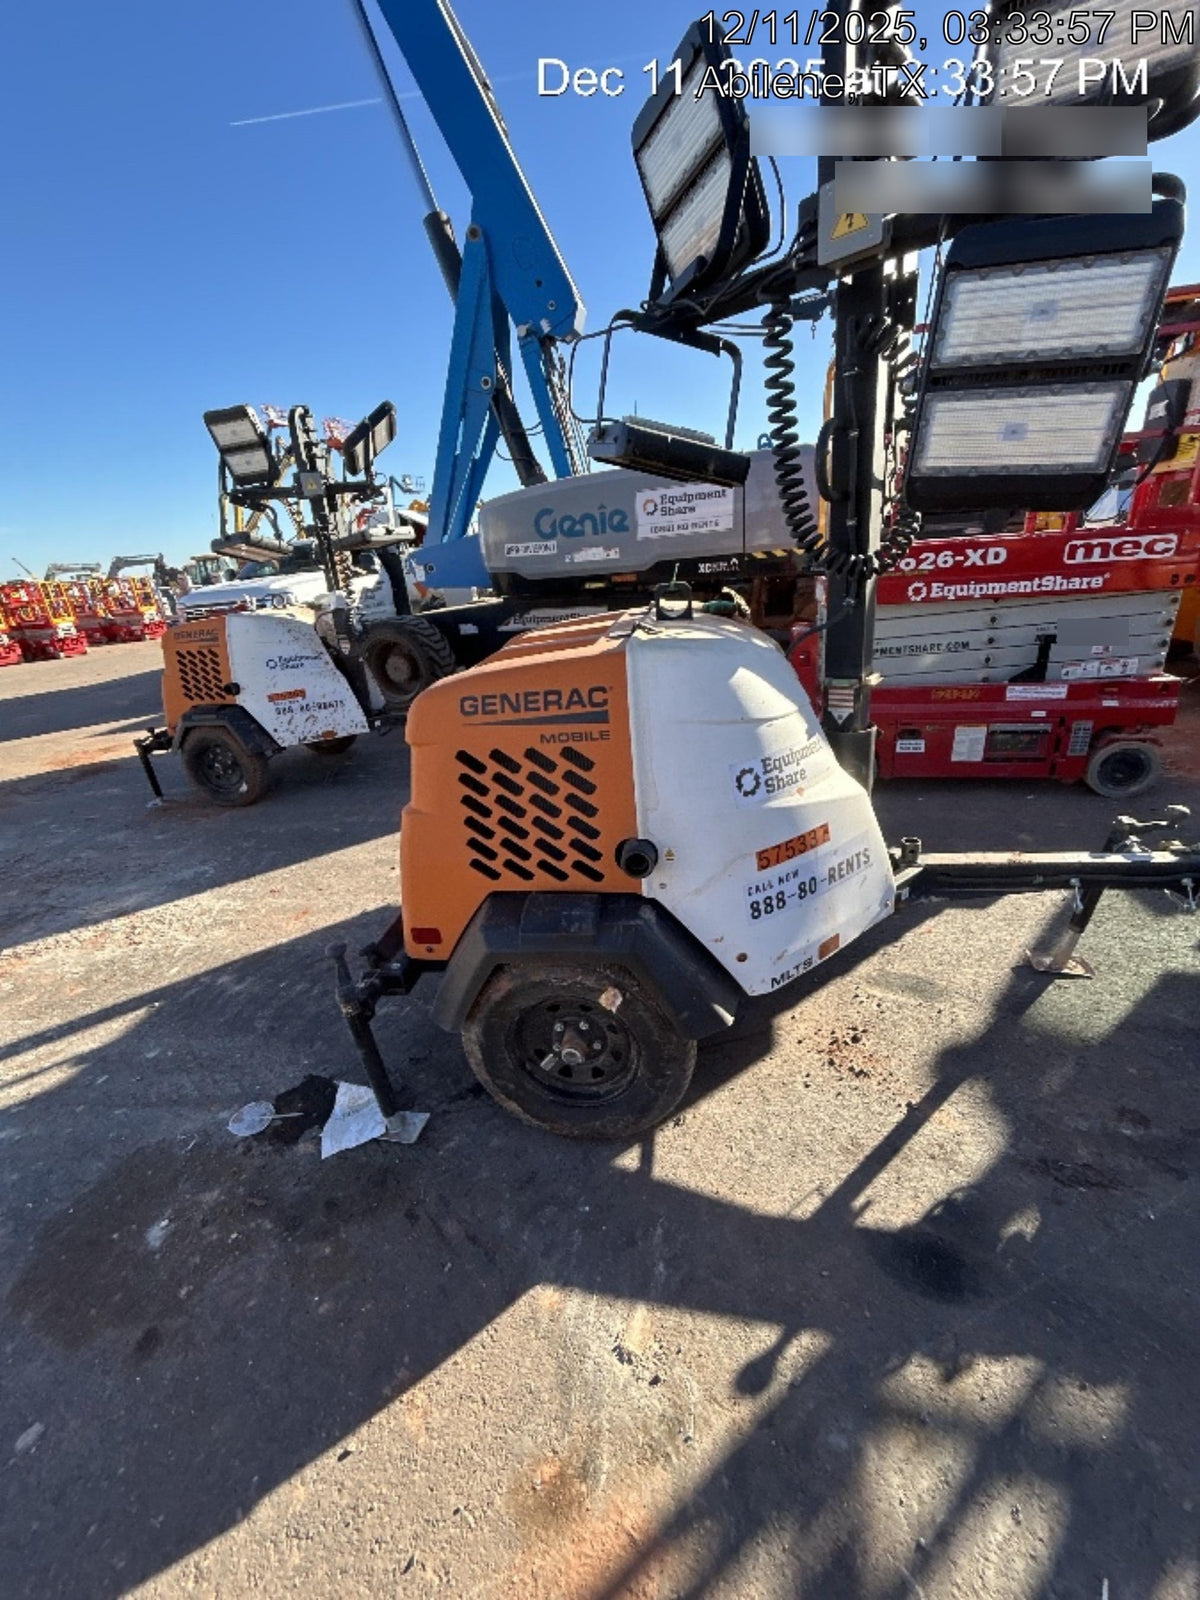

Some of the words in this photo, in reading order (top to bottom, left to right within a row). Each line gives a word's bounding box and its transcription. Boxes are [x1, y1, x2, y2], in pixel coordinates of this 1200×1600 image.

[660, 489, 727, 505] Equipment
[533, 504, 630, 540] Genie
[661, 505, 696, 517] Share
[1065, 537, 1177, 562] mec
[930, 574, 1104, 600] EquipmentShare
[460, 686, 609, 717] GENERAC
[540, 730, 610, 745] MOBILE
[764, 767, 808, 794] Share
[748, 881, 774, 897] CALL
[778, 868, 800, 886] NOW
